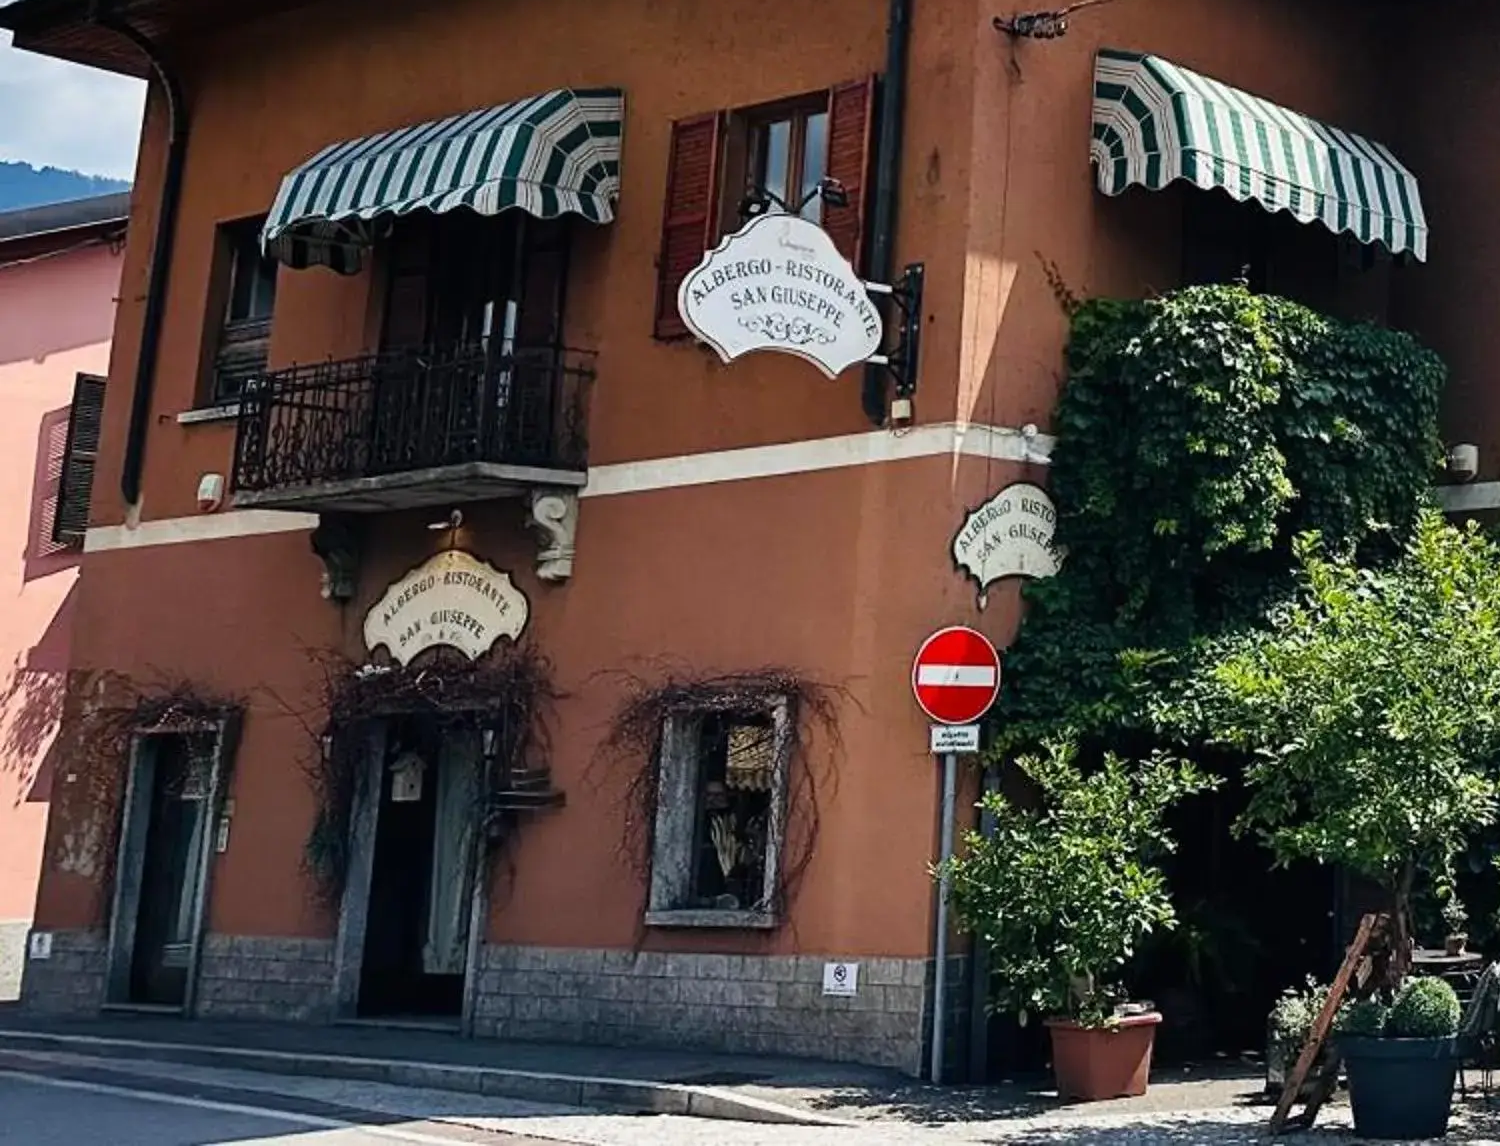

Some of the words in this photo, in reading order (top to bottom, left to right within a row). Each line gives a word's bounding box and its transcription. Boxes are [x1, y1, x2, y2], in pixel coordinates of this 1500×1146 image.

[692, 258, 772, 306] ALBERGO
[786, 260, 880, 338] RISTORANTE
[731, 286, 767, 311] SAN
[771, 285, 846, 329] GIUSEPPE
[1021, 497, 1056, 524] RISTO
